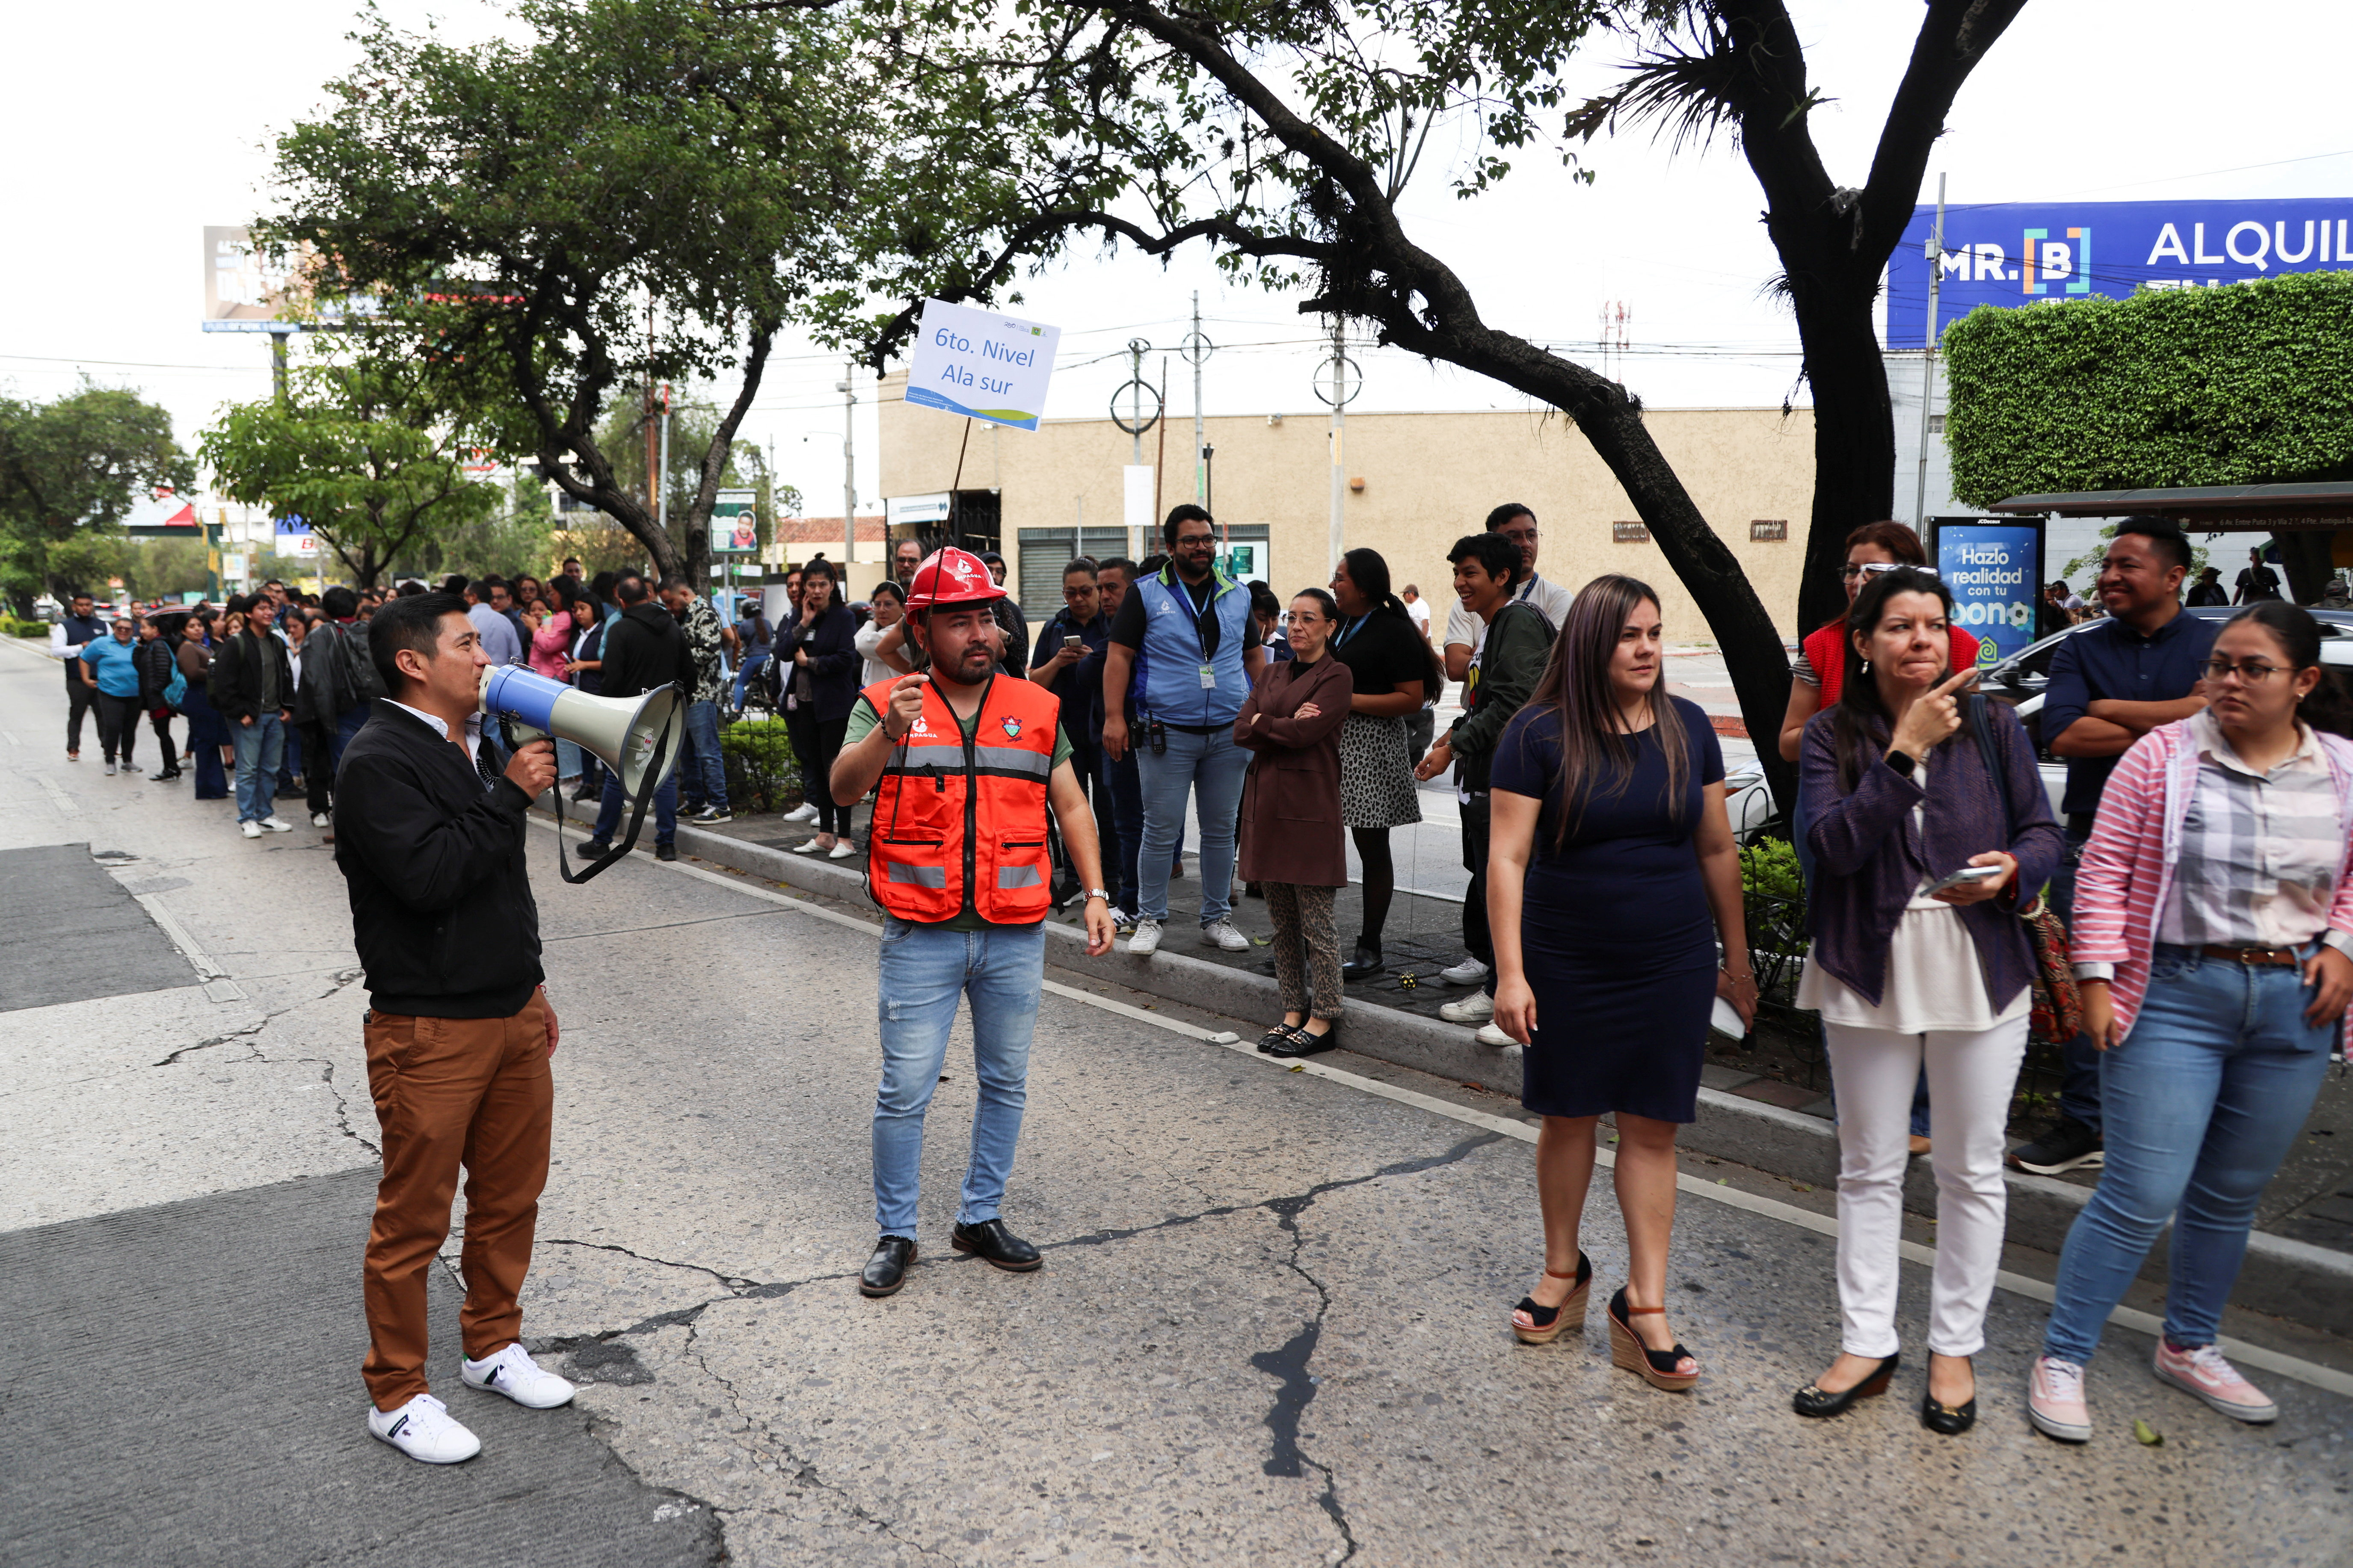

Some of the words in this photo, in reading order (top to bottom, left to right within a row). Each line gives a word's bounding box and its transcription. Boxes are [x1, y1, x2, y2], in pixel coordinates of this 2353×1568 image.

[1939, 243, 2018, 281] MR.
[935, 328, 974, 354] 6to.
[983, 340, 1035, 367] Nivel
[941, 364, 974, 387] Ala
[980, 376, 1013, 395] sur
[2320, 518, 2345, 526] Antigua
[1962, 548, 2009, 565] Hazlo
[1953, 567, 2022, 584] realidad
[1968, 586, 1990, 596] con
[1995, 586, 2007, 596] tu
[392, 1417, 407, 1434] LACOSTE
